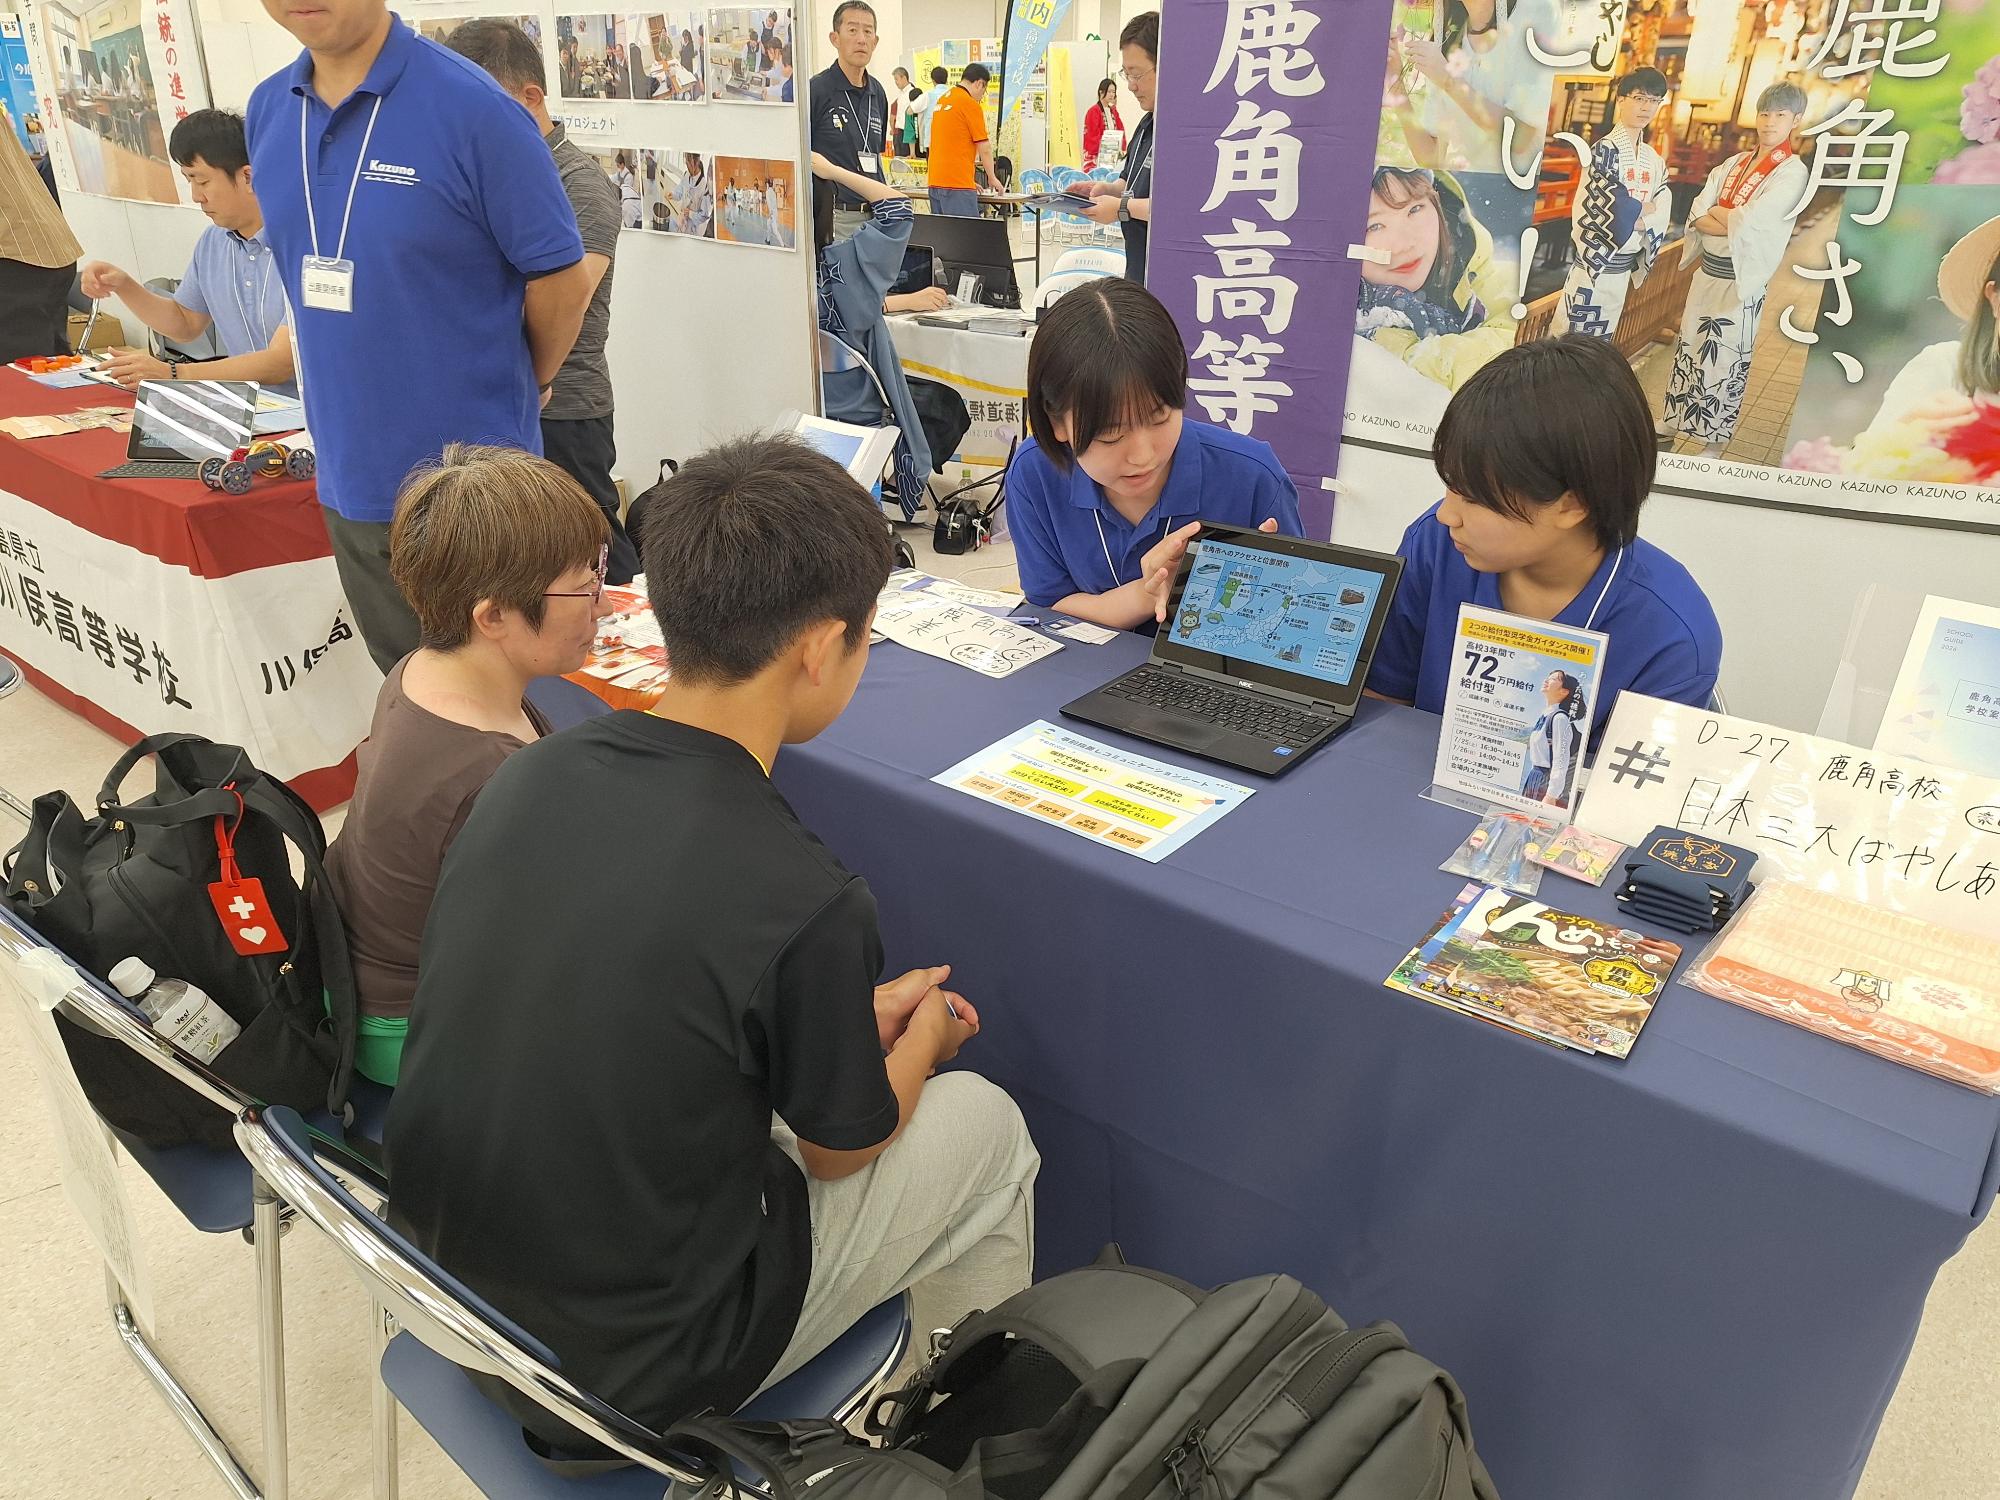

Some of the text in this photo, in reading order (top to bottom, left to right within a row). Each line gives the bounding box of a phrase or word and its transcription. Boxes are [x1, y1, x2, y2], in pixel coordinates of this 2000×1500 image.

[369, 158, 416, 177] Kazuno
[1361, 414, 1401, 429] KAZUNO
[1660, 456, 1711, 473] KAZUNO
[1717, 465, 1770, 482] KAZUNO
[1776, 473, 1833, 490] KAZUNO
[1840, 480, 1898, 496] KAZUNO
[1906, 485, 1968, 502] KAZUNO
[1943, 636, 1964, 645] GUIDE
[1946, 628, 1975, 639] SCHOOL
[1466, 641, 1516, 660] 高校3年間で
[1238, 680, 1254, 690] NEC
[1460, 676, 1496, 695] 給付型
[1697, 719, 1943, 801] D-27 鹿角高校
